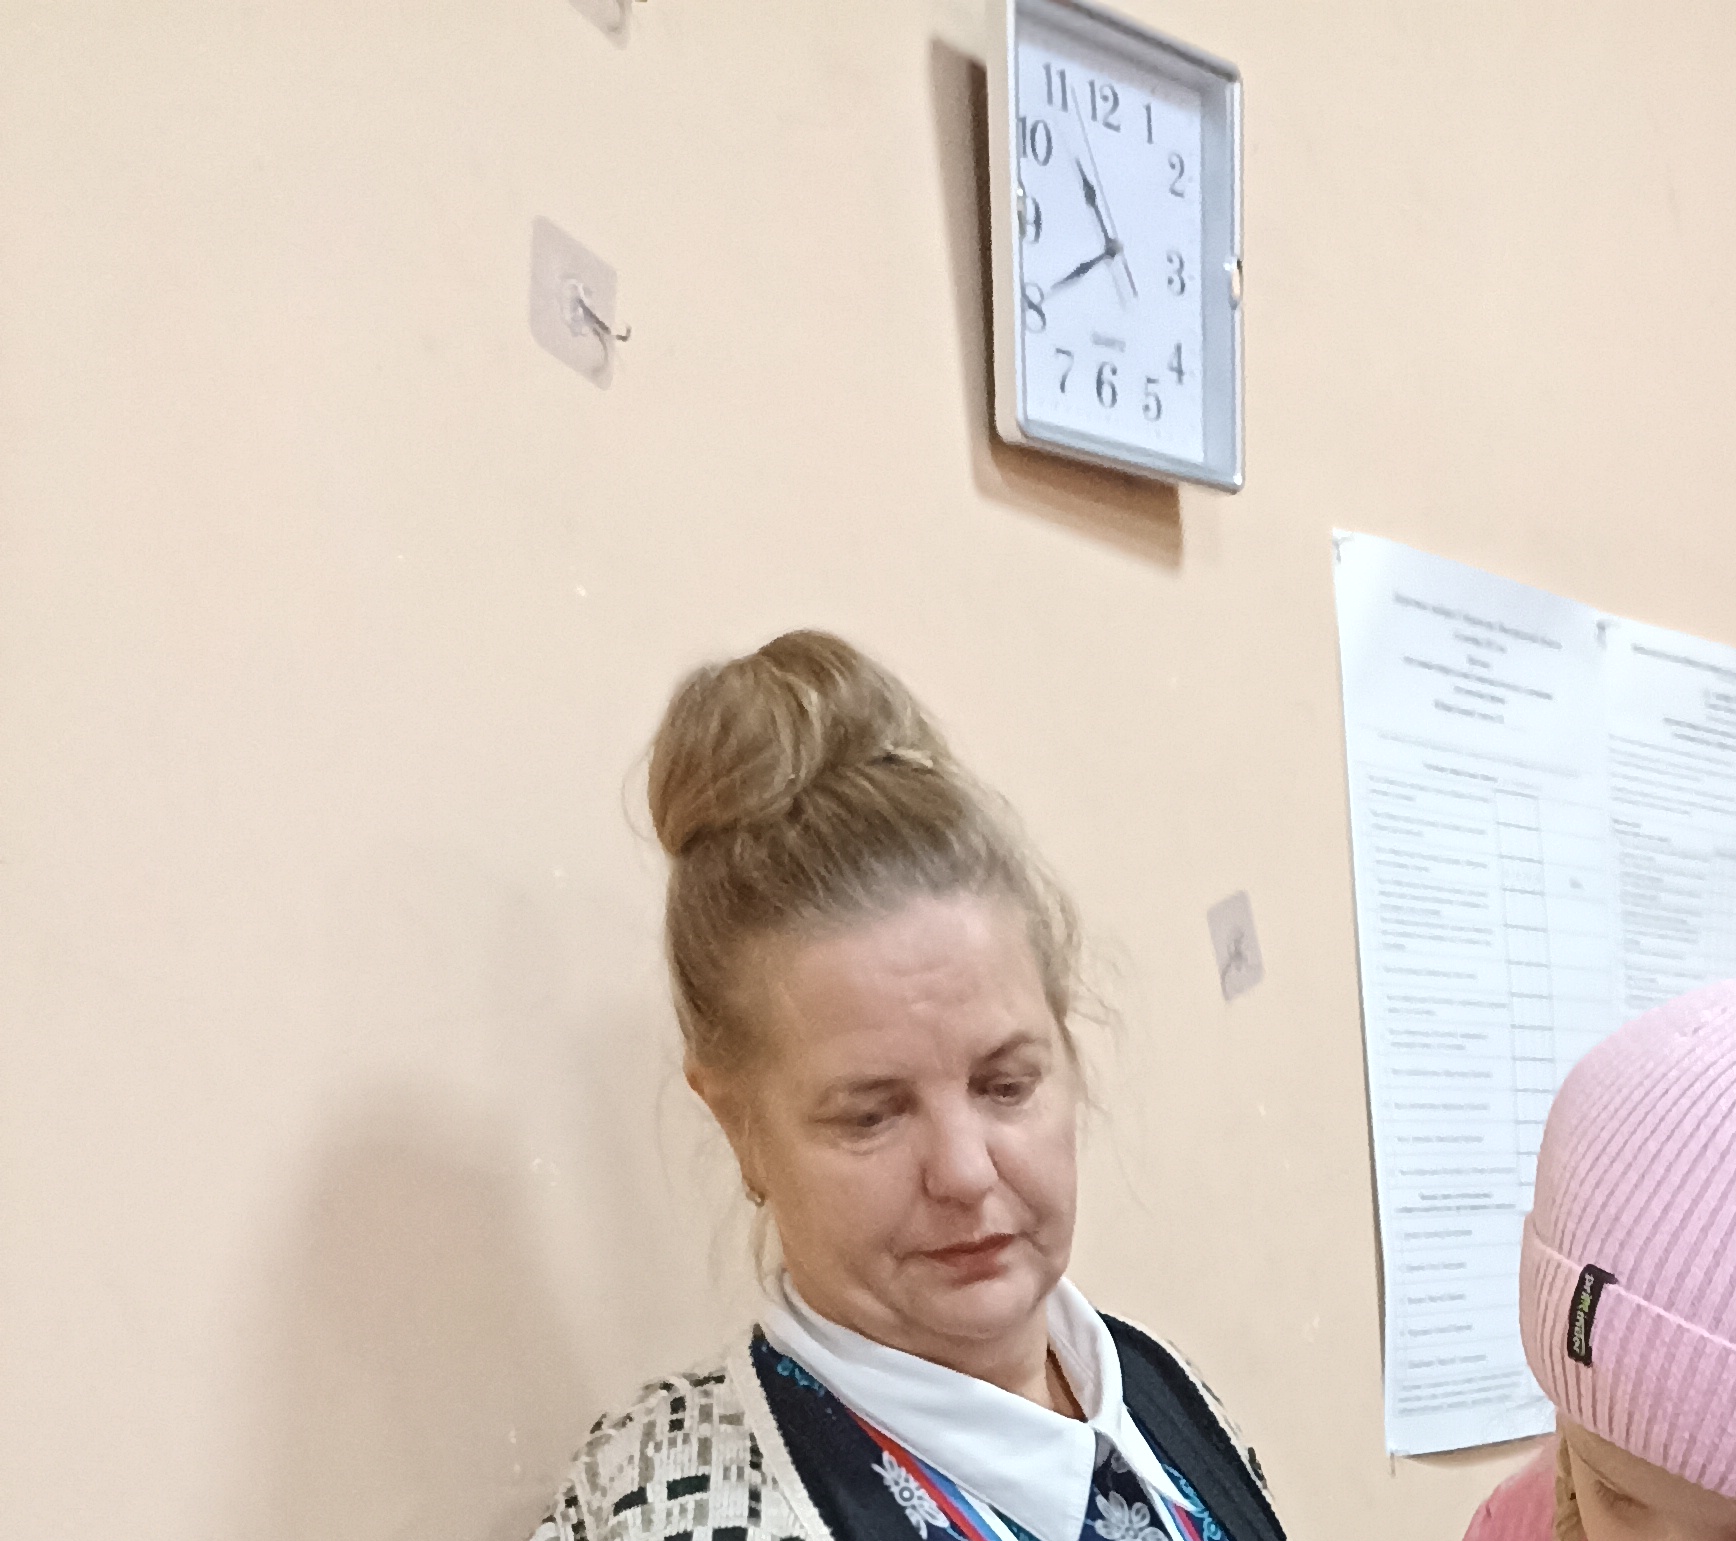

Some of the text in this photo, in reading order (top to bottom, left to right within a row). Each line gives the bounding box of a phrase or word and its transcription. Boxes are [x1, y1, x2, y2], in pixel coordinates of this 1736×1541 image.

[1043, 62, 1068, 113] 11
[1088, 79, 1121, 133] 12
[1017, 115, 1052, 166] 10
[1144, 102, 1153, 144] 1
[1168, 152, 1185, 198] 2
[1021, 197, 1042, 244] 9
[1167, 250, 1185, 296] 3
[1023, 282, 1046, 333] 8
[1055, 348, 1074, 394] 7
[1096, 361, 1118, 408] 6
[1167, 342, 1184, 385] 4
[1142, 375, 1162, 421] 5
